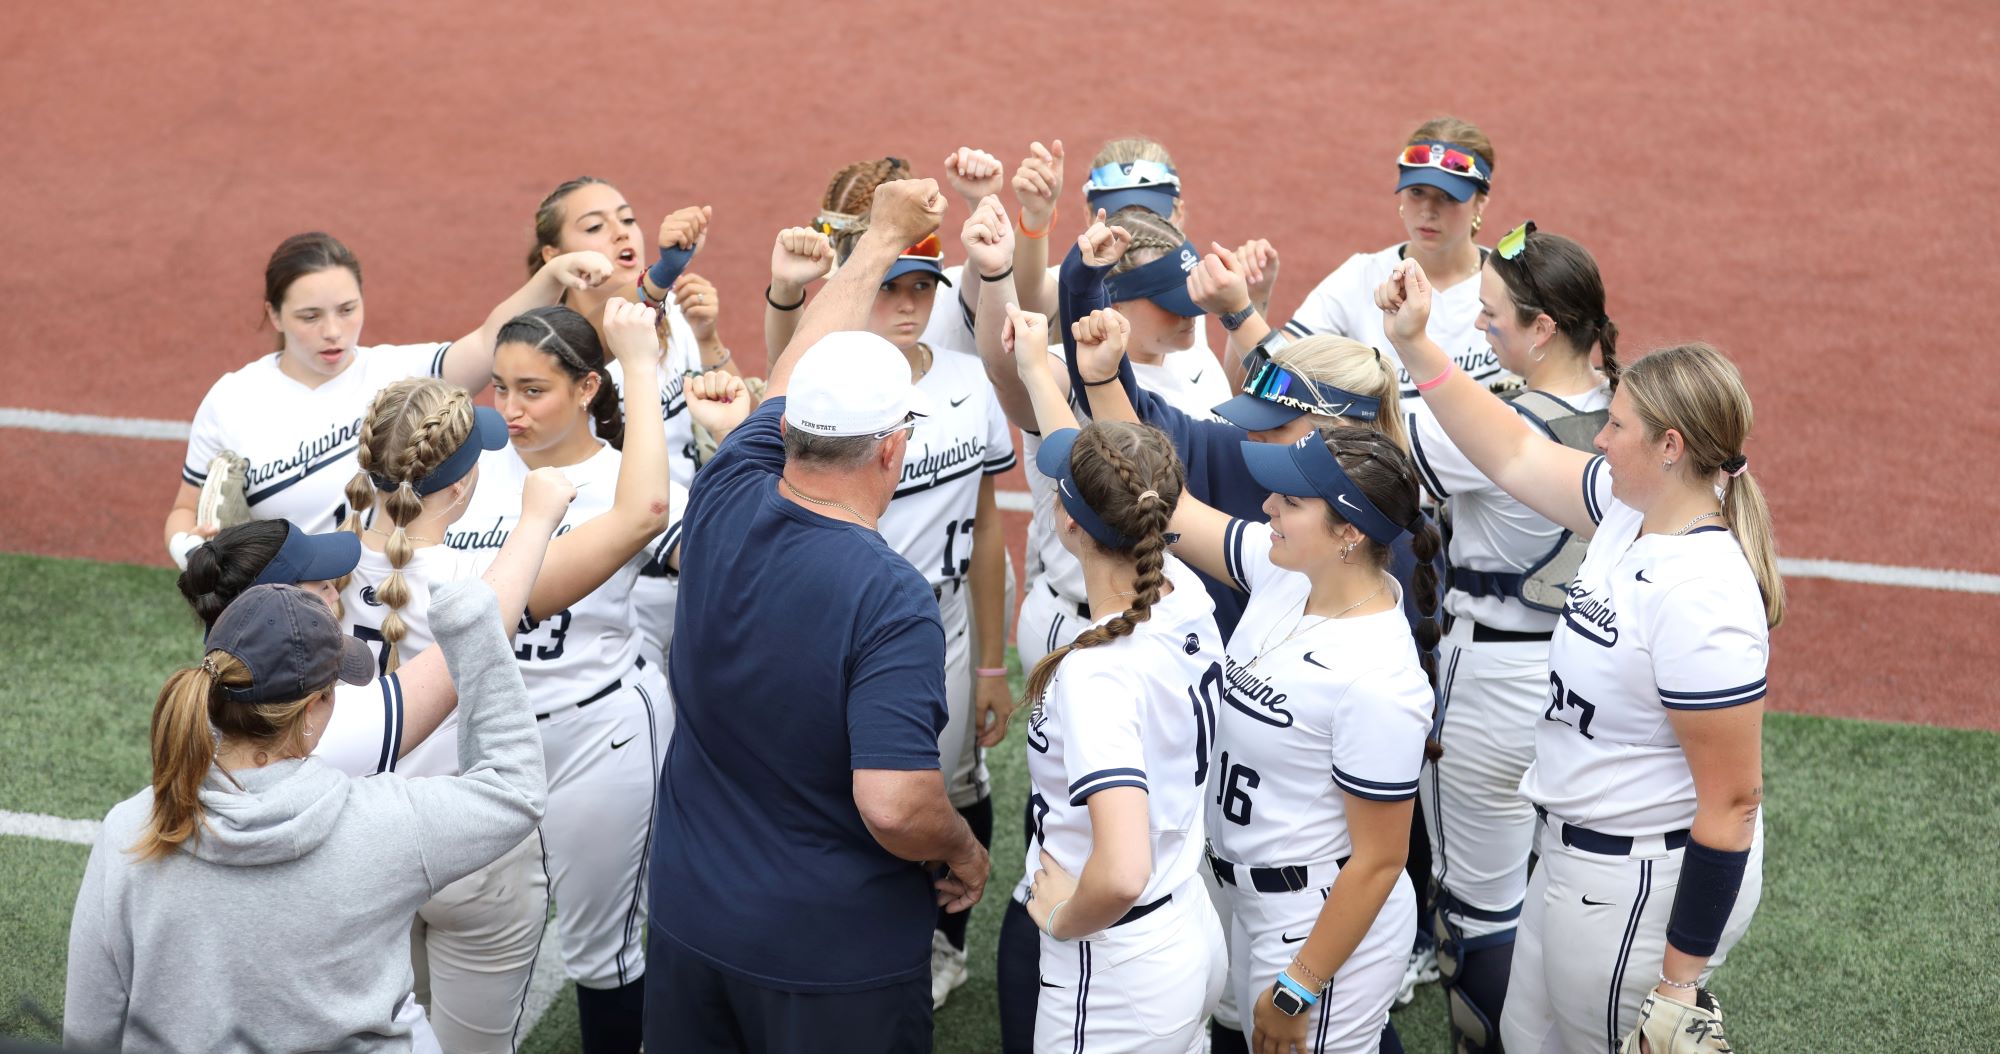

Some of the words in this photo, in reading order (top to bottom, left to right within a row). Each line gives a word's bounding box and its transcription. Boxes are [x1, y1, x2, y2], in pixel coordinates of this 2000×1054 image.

[801, 420, 815, 429] PENN
[816, 424, 837, 432] STATE
[1216, 750, 1261, 827] 16
